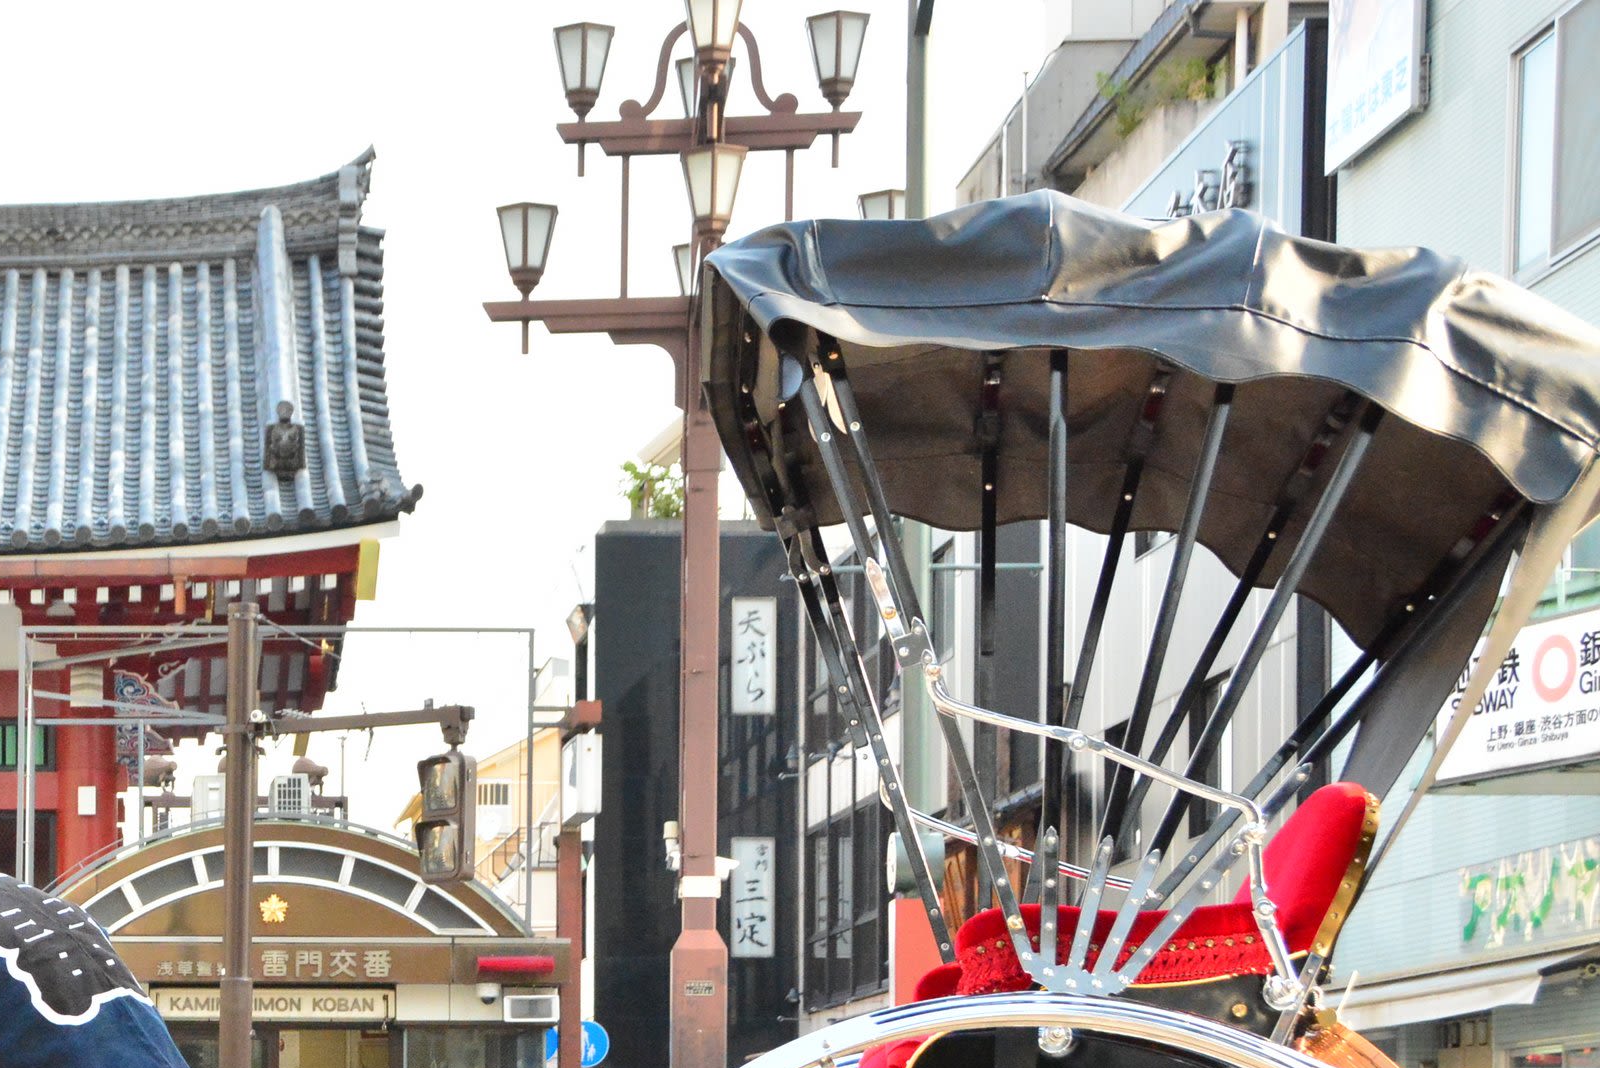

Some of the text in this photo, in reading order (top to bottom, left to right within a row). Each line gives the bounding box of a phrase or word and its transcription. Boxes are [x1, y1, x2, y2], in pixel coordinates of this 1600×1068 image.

[737, 610, 766, 702] 天ぷら
[736, 879, 769, 948] 三定
[261, 949, 392, 978] 雷門交番
[169, 997, 375, 1012] KAMIIMON KOBAN
